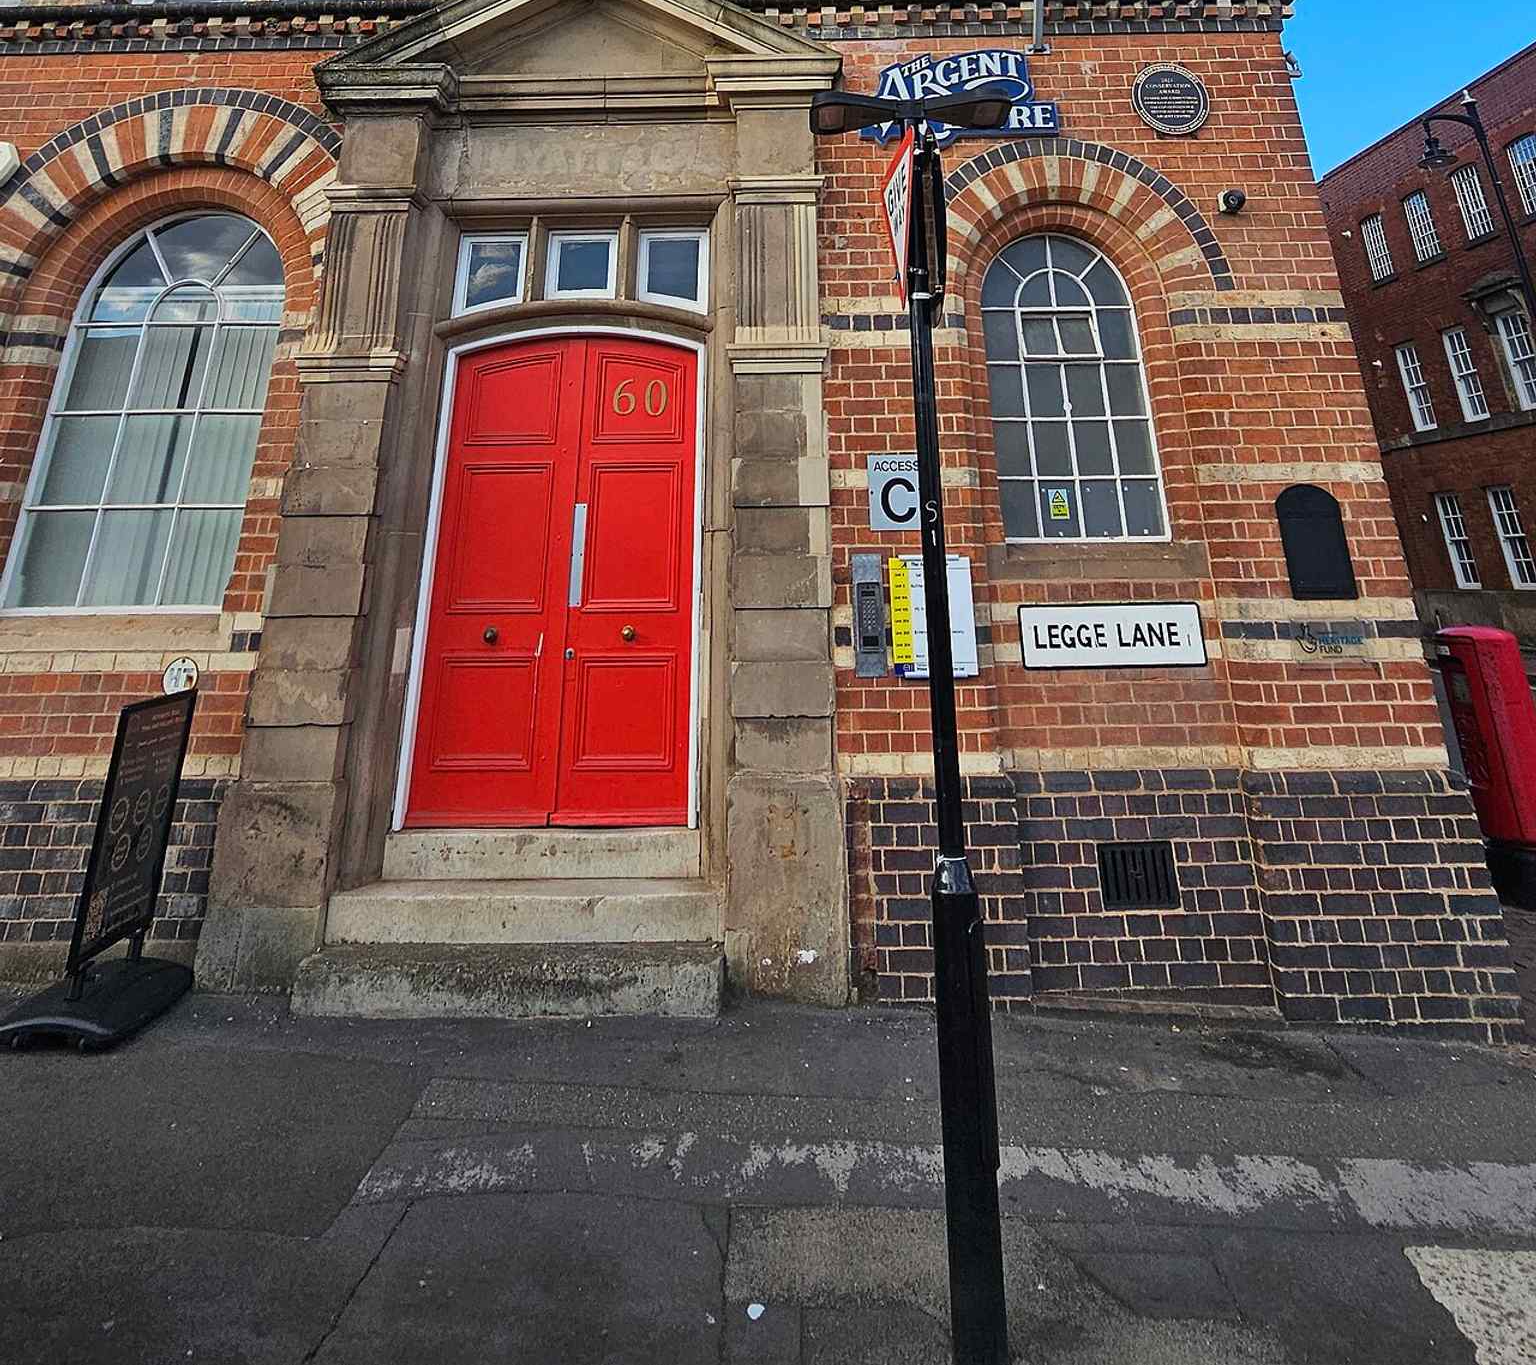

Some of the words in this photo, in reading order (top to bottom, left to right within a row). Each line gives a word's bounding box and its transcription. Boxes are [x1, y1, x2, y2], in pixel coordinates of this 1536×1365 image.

[882, 51, 1023, 100] ARGENT
[901, 55, 931, 77] THE
[612, 378, 669, 417] 60
[873, 460, 919, 472] ACCESS
[881, 477, 917, 523] C
[1033, 624, 1108, 649] LEGGE
[1116, 622, 1181, 647] LANE
[1318, 635, 1364, 645] HERITAGE
[1319, 645, 1343, 654] FUND
